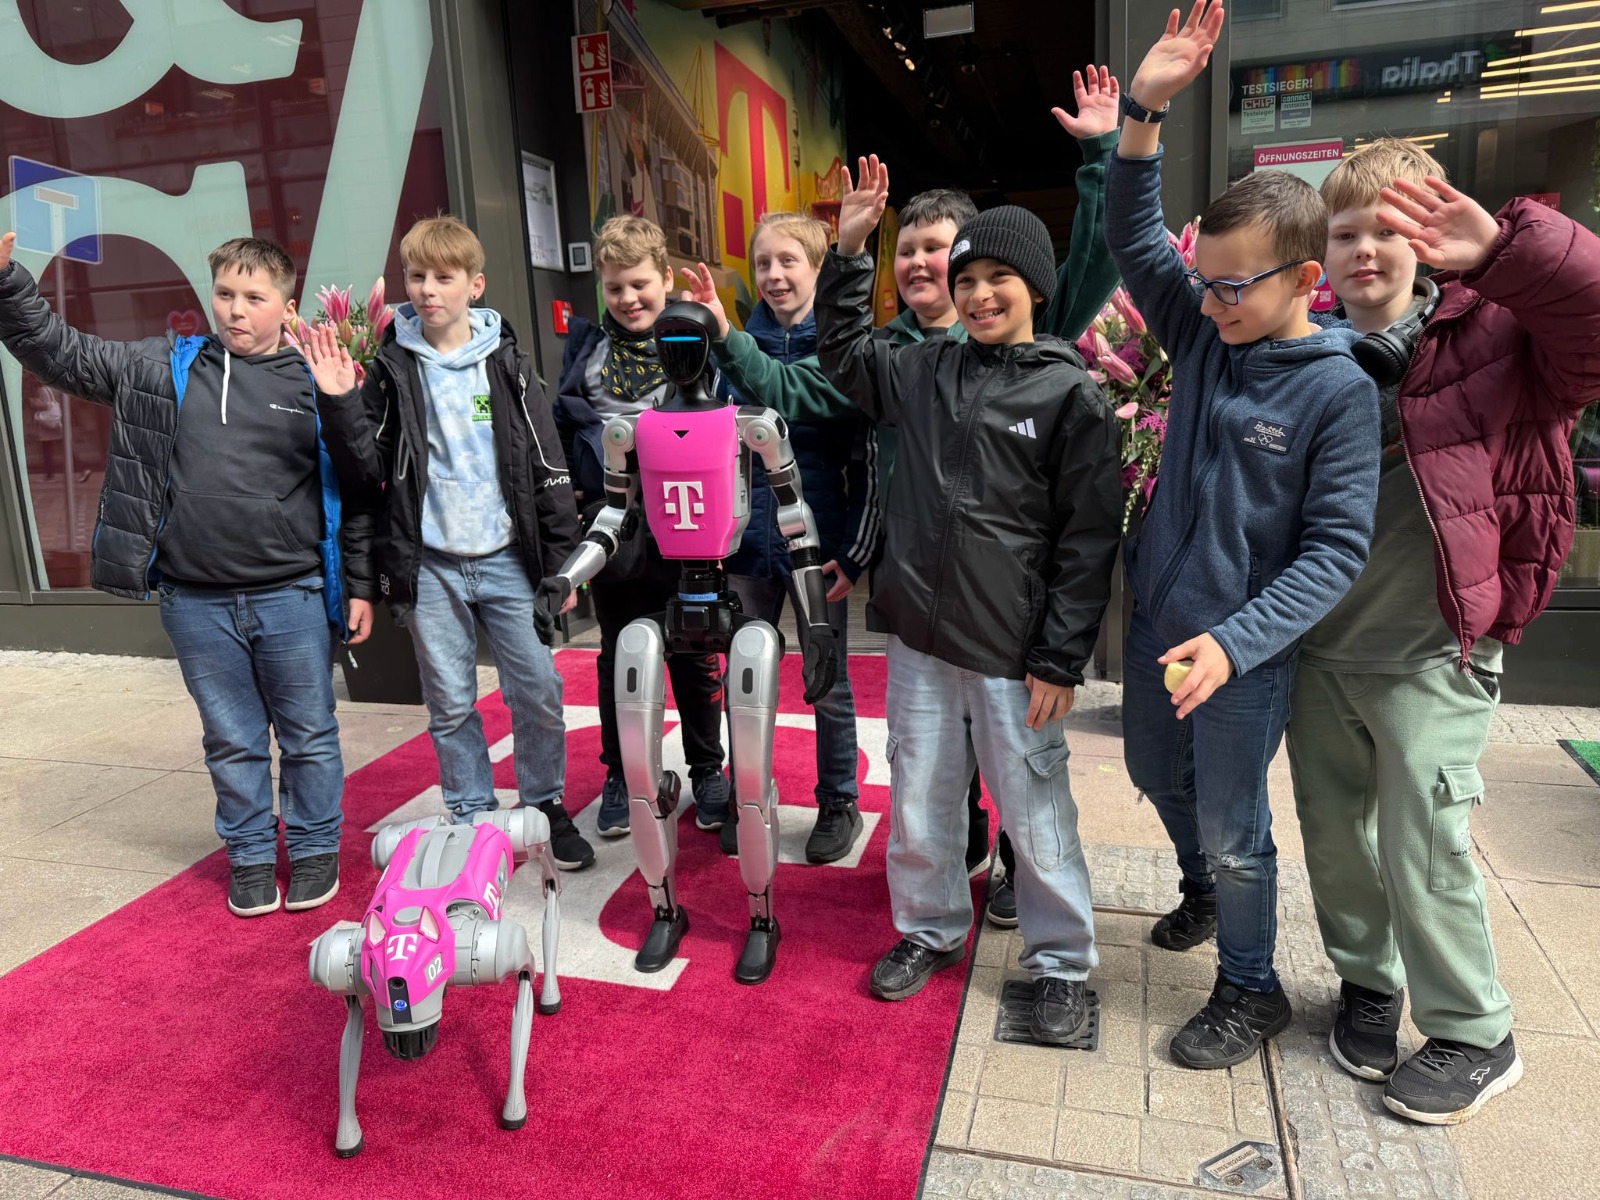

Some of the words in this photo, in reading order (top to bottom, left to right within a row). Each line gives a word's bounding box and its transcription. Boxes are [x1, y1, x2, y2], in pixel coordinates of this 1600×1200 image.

[1242, 78, 1313, 96] TESTSIEGER!
[1244, 98, 1274, 109] CHIP
[1282, 93, 1311, 102] connect
[1243, 109, 1274, 117] Testsieger
[1258, 148, 1339, 163] ÖFFNUNGSZEITEN
[663, 481, 704, 529] T
[387, 933, 418, 961] T
[428, 958, 443, 981] 02
